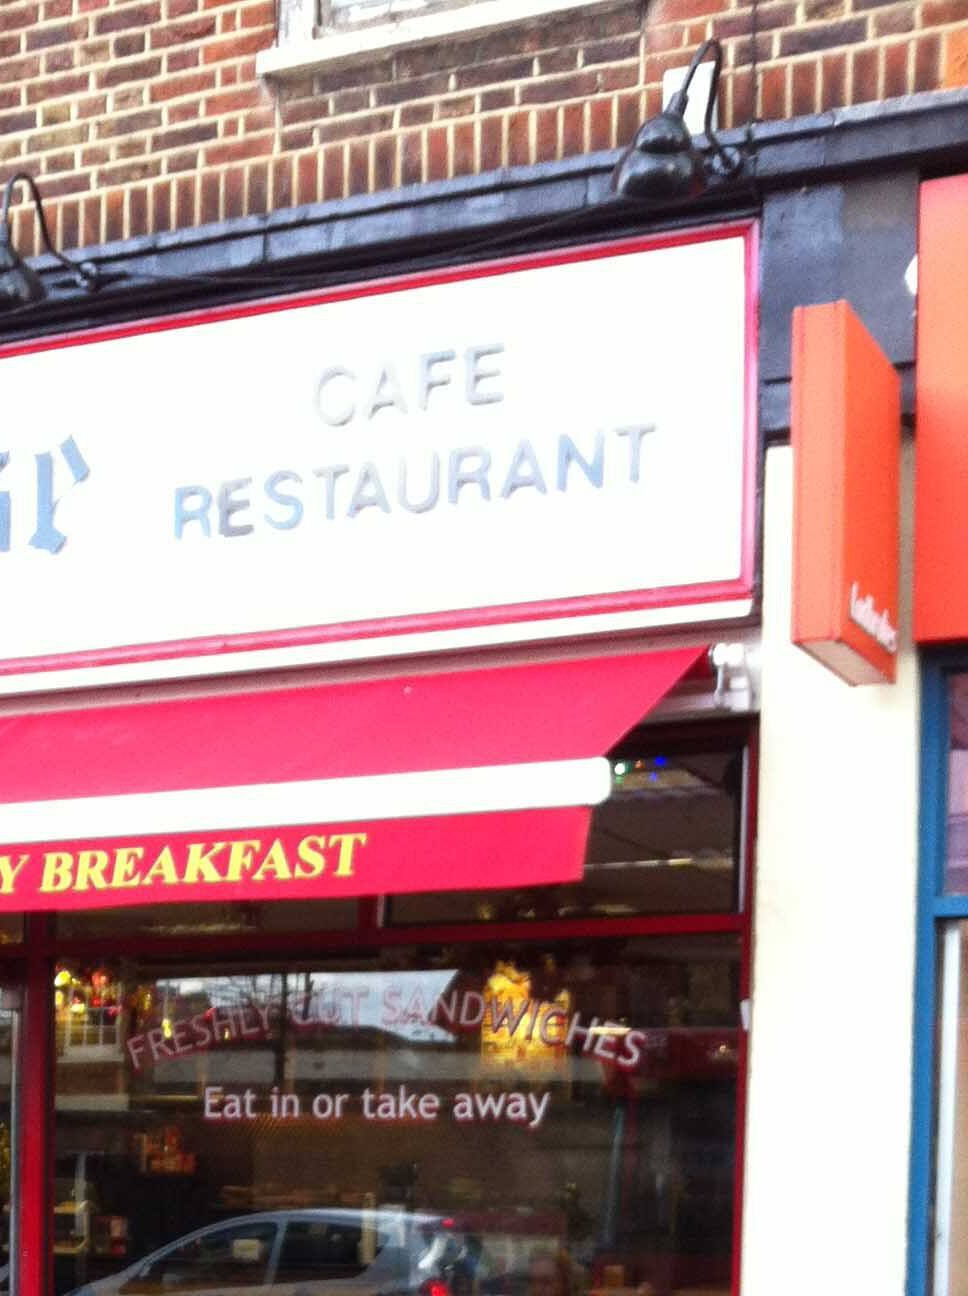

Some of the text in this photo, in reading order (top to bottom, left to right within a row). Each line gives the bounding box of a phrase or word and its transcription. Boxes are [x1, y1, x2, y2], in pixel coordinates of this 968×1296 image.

[313, 342, 507, 427] CAFE
[172, 423, 656, 539] RESTAURANT
[39, 833, 367, 892] BREAKFAST
[126, 984, 648, 1069] FRESHLY CUT SANDWICHES
[203, 1086, 551, 1126] Eat in or take away
